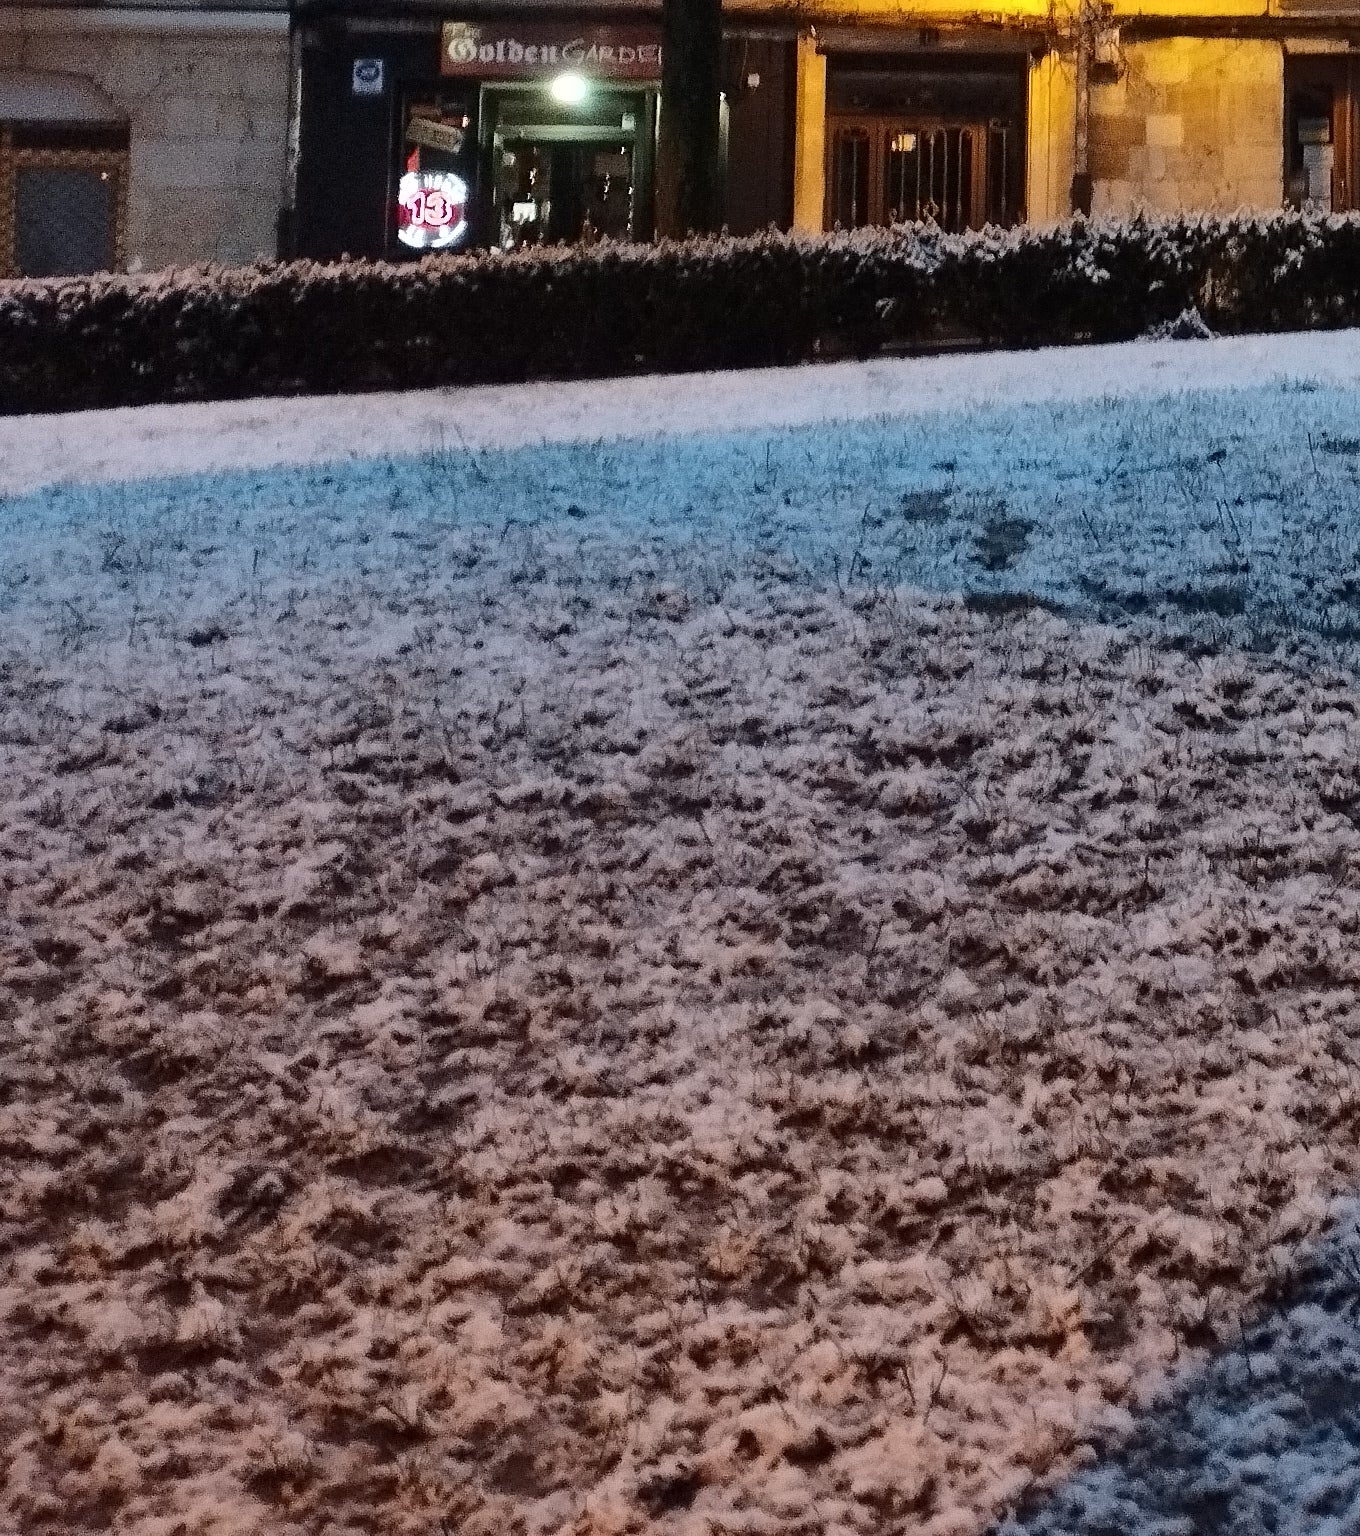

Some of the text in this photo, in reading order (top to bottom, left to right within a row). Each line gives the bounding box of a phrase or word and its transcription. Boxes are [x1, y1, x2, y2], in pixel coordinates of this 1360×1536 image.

[448, 37, 662, 66] Golden GARDE
[406, 191, 453, 226] 13
